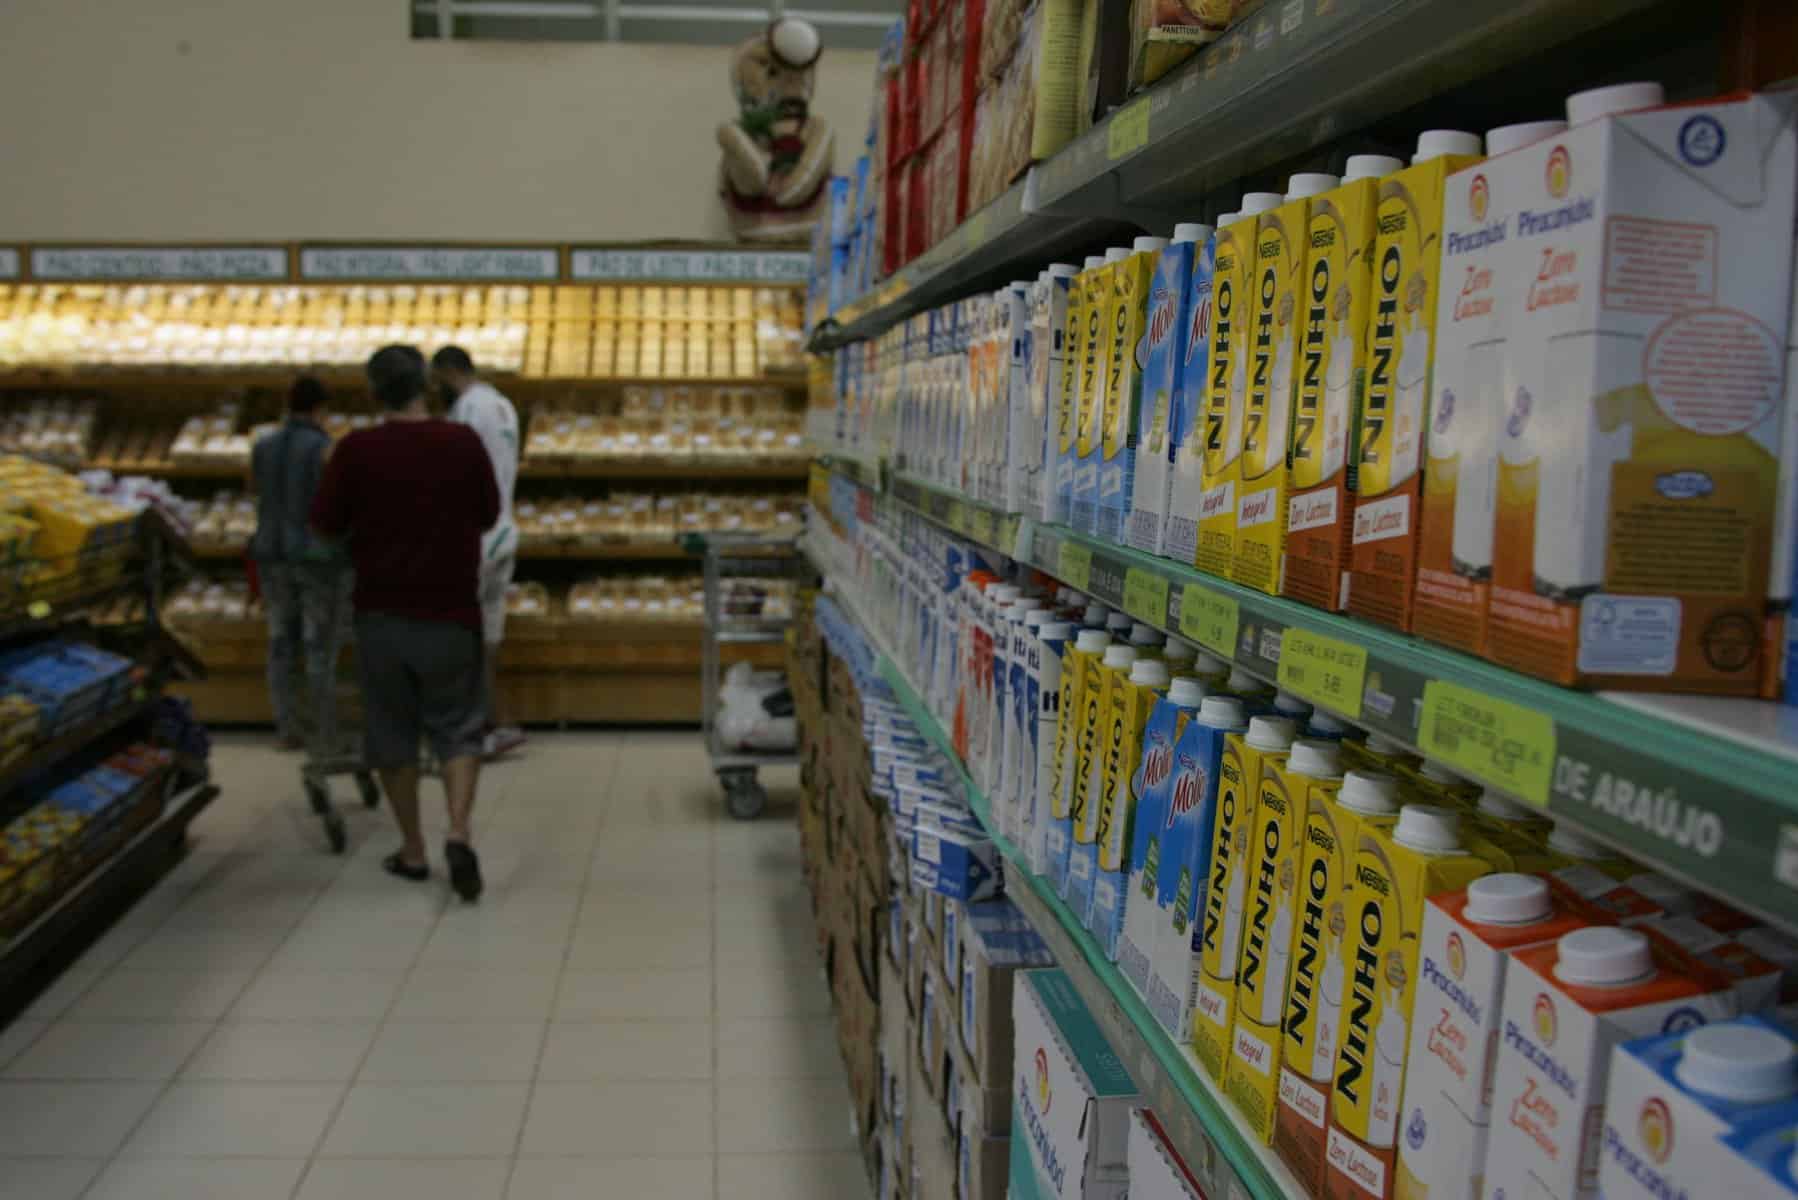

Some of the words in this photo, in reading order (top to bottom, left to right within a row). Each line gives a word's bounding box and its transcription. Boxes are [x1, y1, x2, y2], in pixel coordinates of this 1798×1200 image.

[1078, 310, 1099, 438] NINHO
[1103, 304, 1126, 441] NINHO
[1207, 280, 1232, 450] NINHO
[1245, 268, 1276, 451] NINHO
[1294, 258, 1330, 459] NINHO
[1360, 245, 1401, 464] NINHO
[1075, 700, 1097, 822] NINHO
[1099, 717, 1122, 848] NINHO
[1553, 756, 1591, 802] DE
[1591, 771, 1724, 858] ARAÚJO
[1203, 790, 1236, 951] NINHO
[1242, 820, 1280, 993] NINHO
[1286, 858, 1328, 1045] NINHO
[1336, 901, 1382, 1105] NINHO
